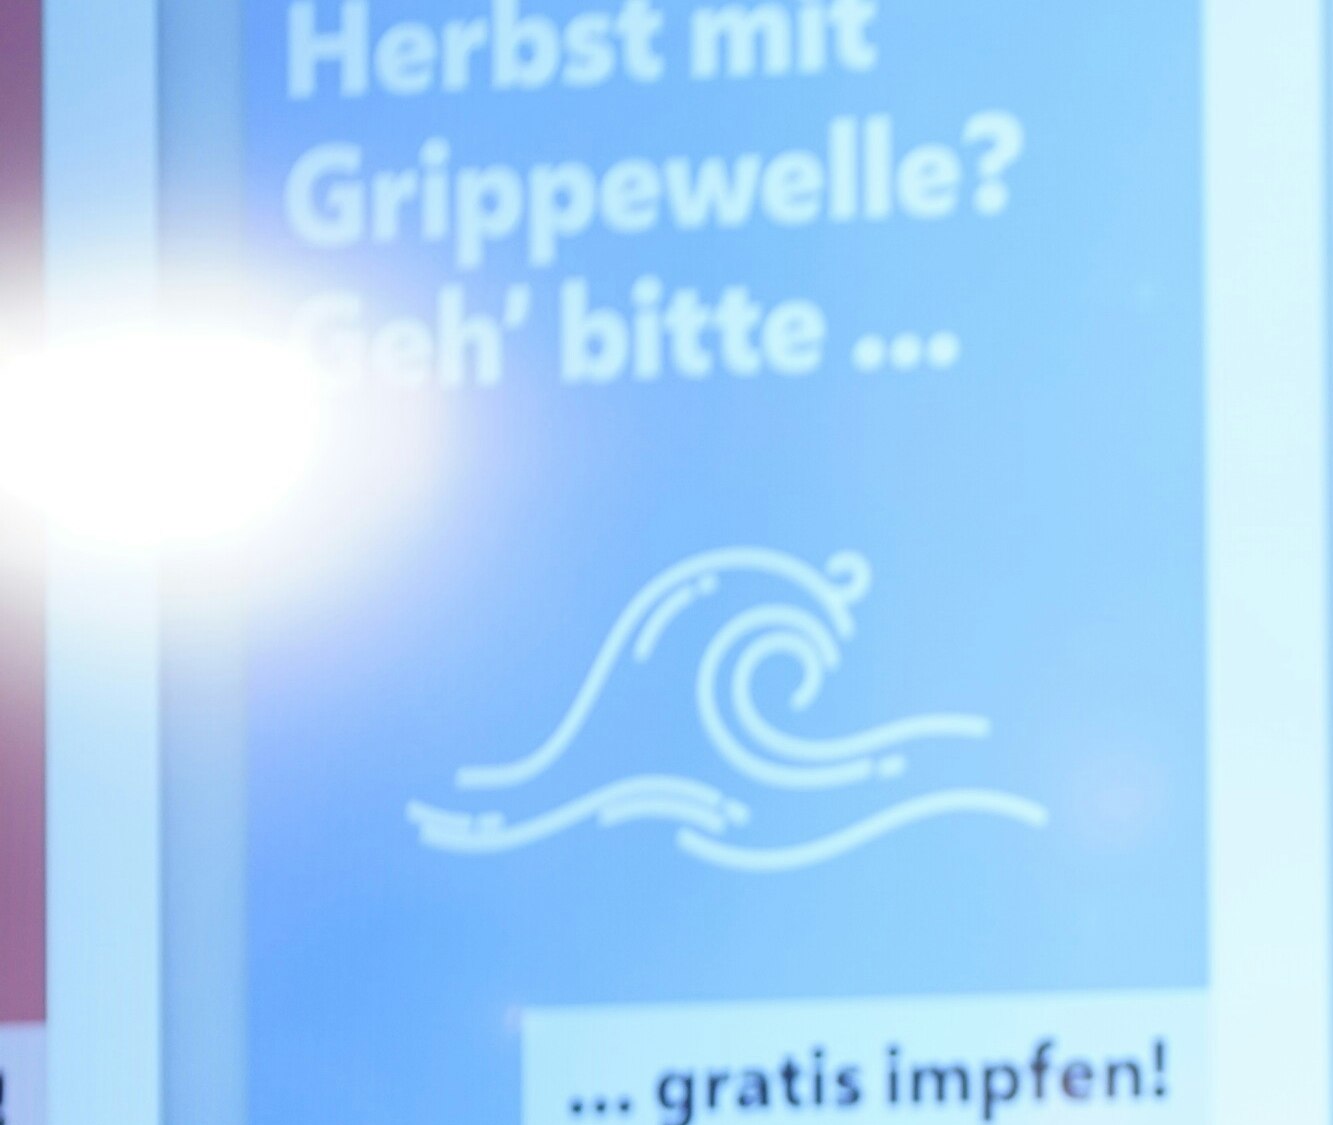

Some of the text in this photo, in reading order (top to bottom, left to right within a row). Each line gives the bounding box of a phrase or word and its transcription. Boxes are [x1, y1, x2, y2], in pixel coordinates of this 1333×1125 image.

[286, 0, 879, 99] Herbst mit
[283, 109, 1027, 270] Grippewelle?
[560, 275, 827, 385] bitte
[885, 1037, 1169, 1123] impfen!
